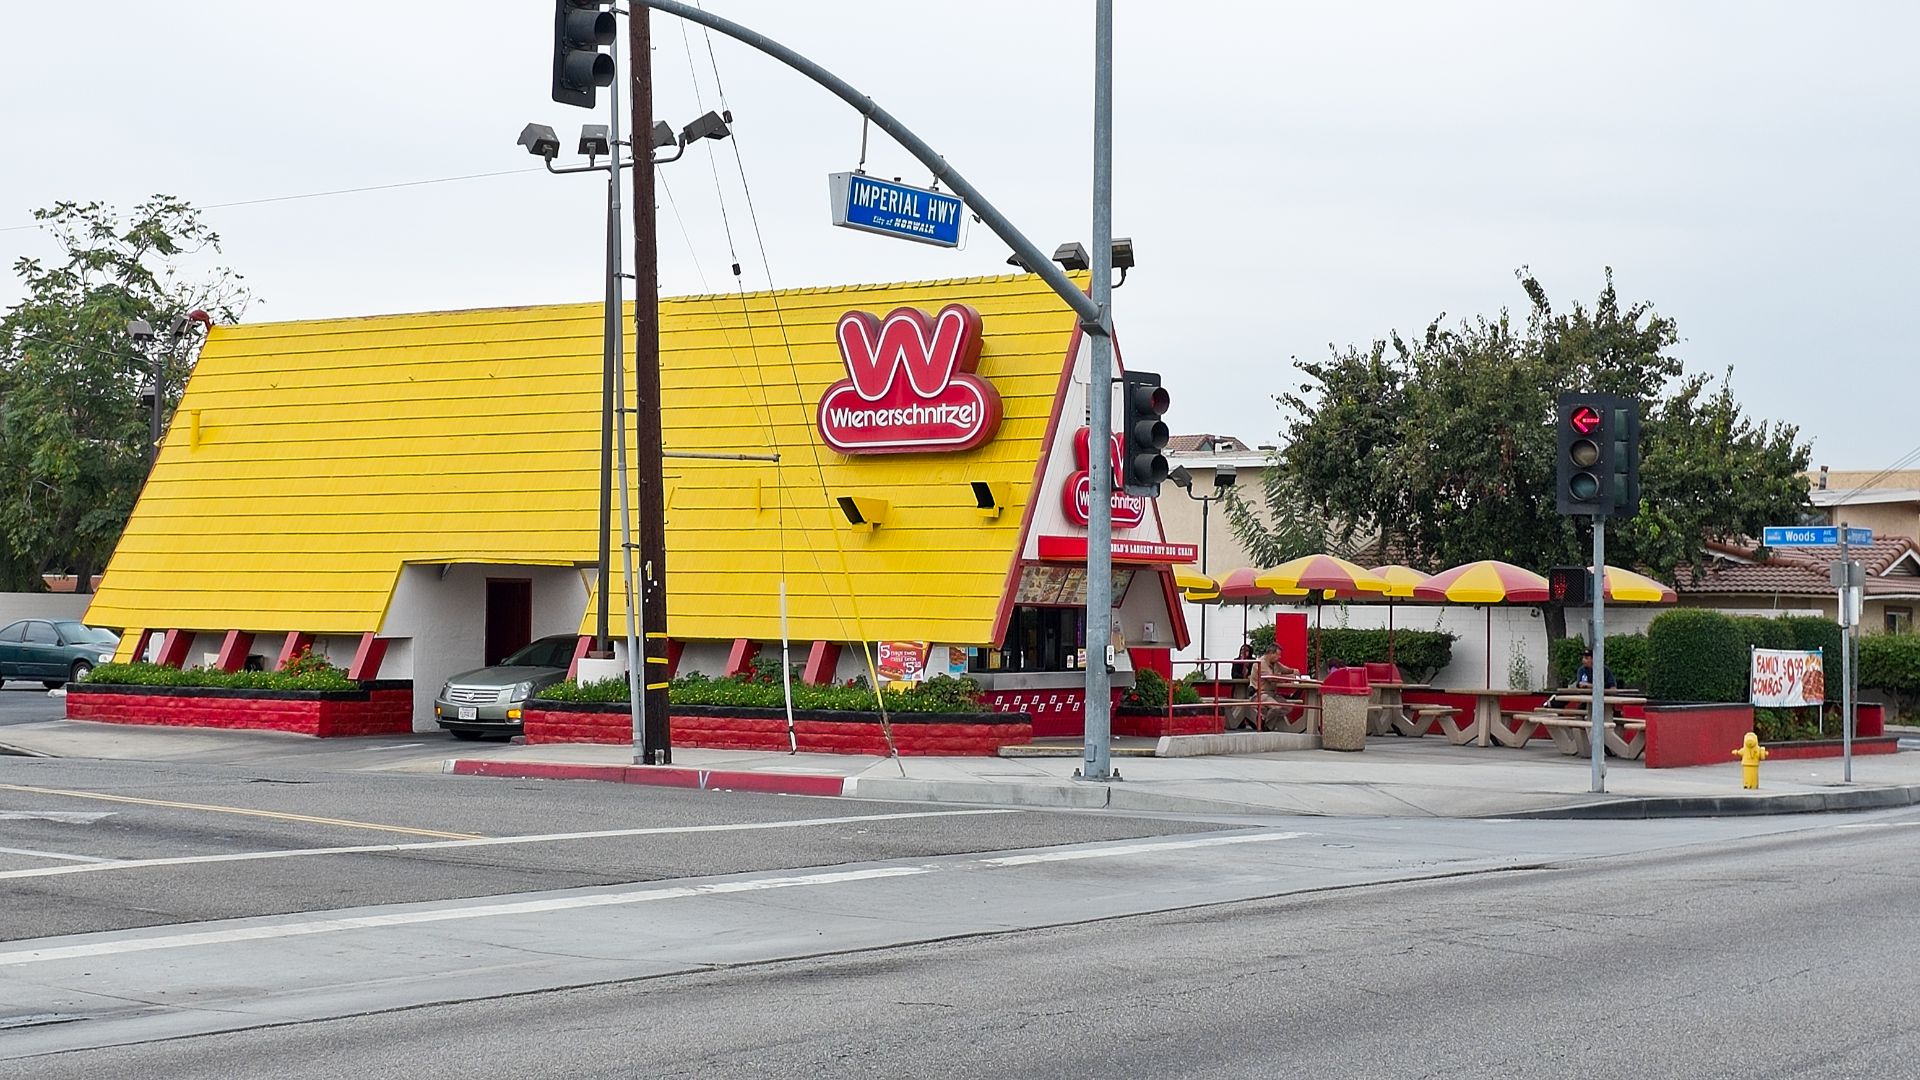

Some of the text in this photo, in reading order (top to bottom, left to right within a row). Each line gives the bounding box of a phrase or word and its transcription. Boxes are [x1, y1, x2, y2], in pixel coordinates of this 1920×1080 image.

[853, 182, 957, 225] IMPERIAL HWY
[894, 217, 936, 235] NORWALK
[839, 309, 965, 402] W
[830, 401, 977, 429] Wienerschnitzel
[1785, 530, 1816, 542] Woods
[1130, 544, 1154, 554] LARGEST
[1154, 546, 1165, 555] HOT
[1177, 547, 1193, 556] CHAIN
[1756, 655, 1779, 675] FAMILY
[1752, 677, 1783, 696] COMBOS
